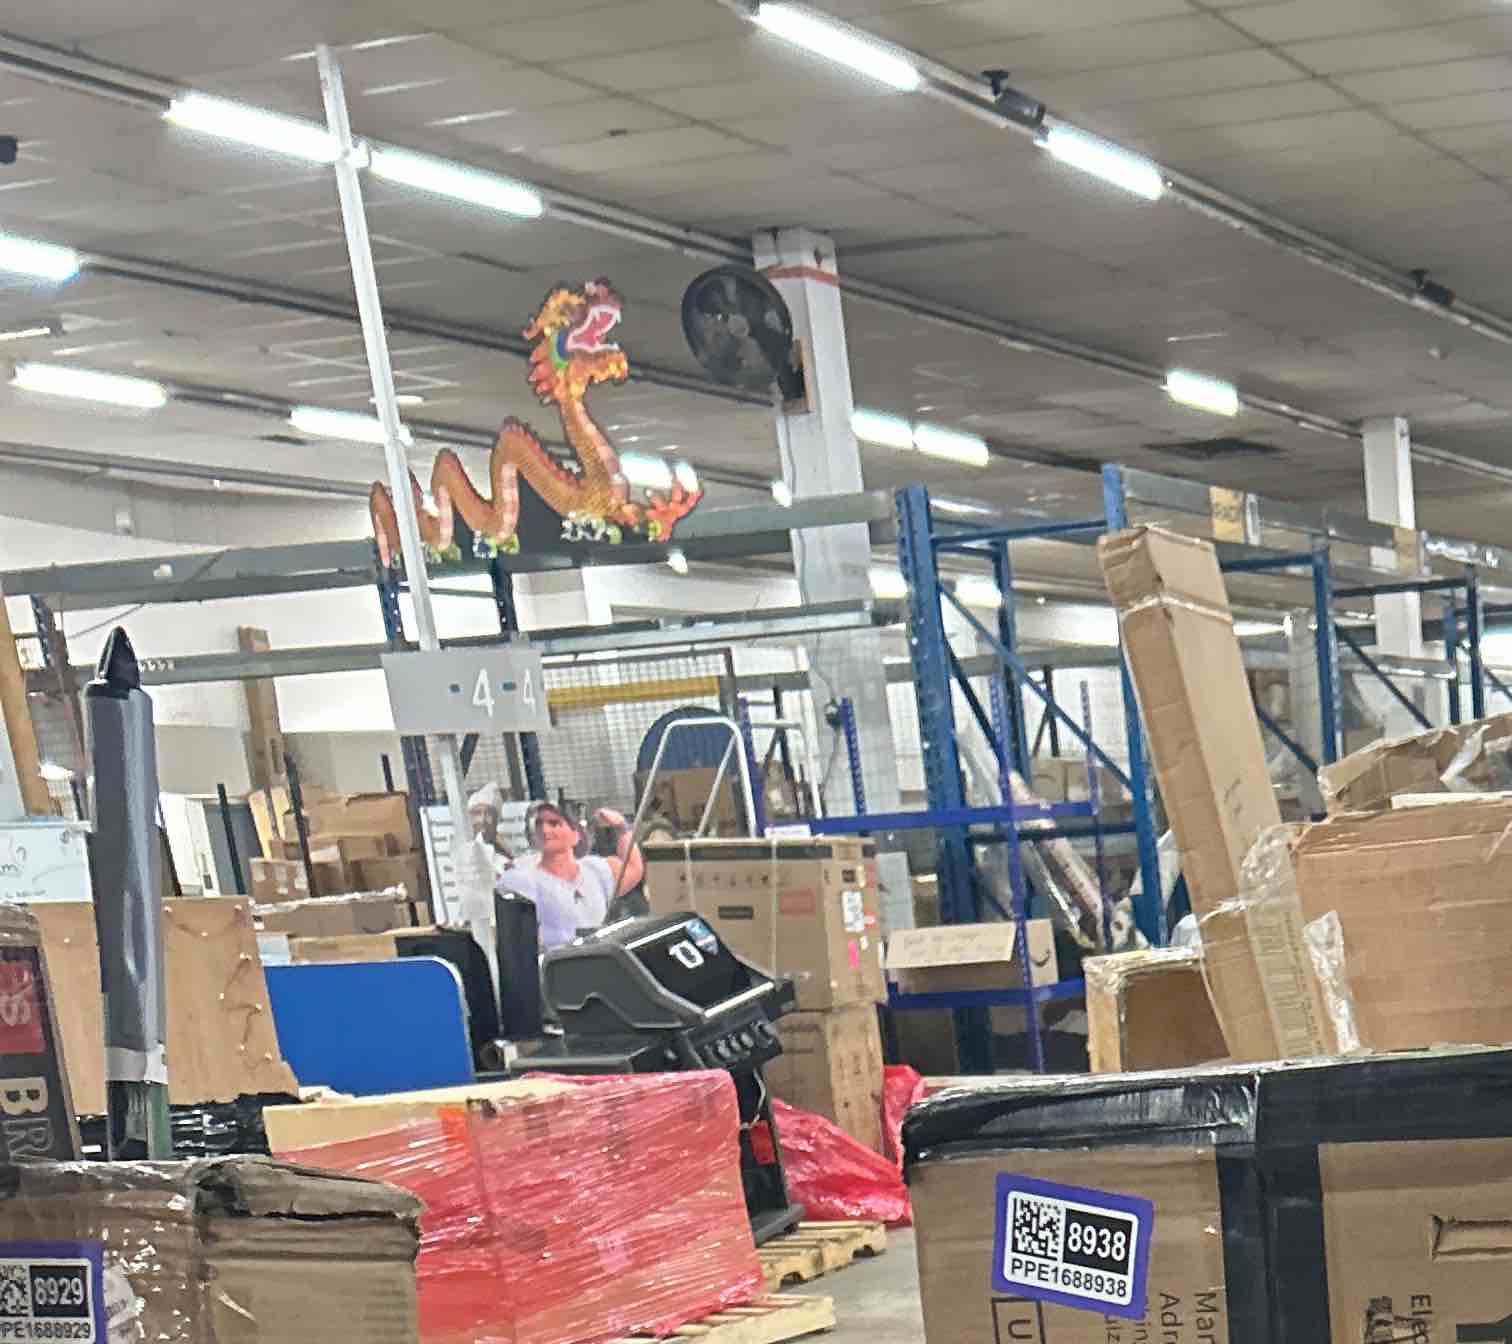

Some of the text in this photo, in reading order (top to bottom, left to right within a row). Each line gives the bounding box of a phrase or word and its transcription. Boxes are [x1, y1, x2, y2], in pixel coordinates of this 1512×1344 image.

[1067, 1221, 1127, 1262] 8938
[33, 1276, 85, 1306] 8929
[1010, 1257, 1128, 1298] PPE1688938
